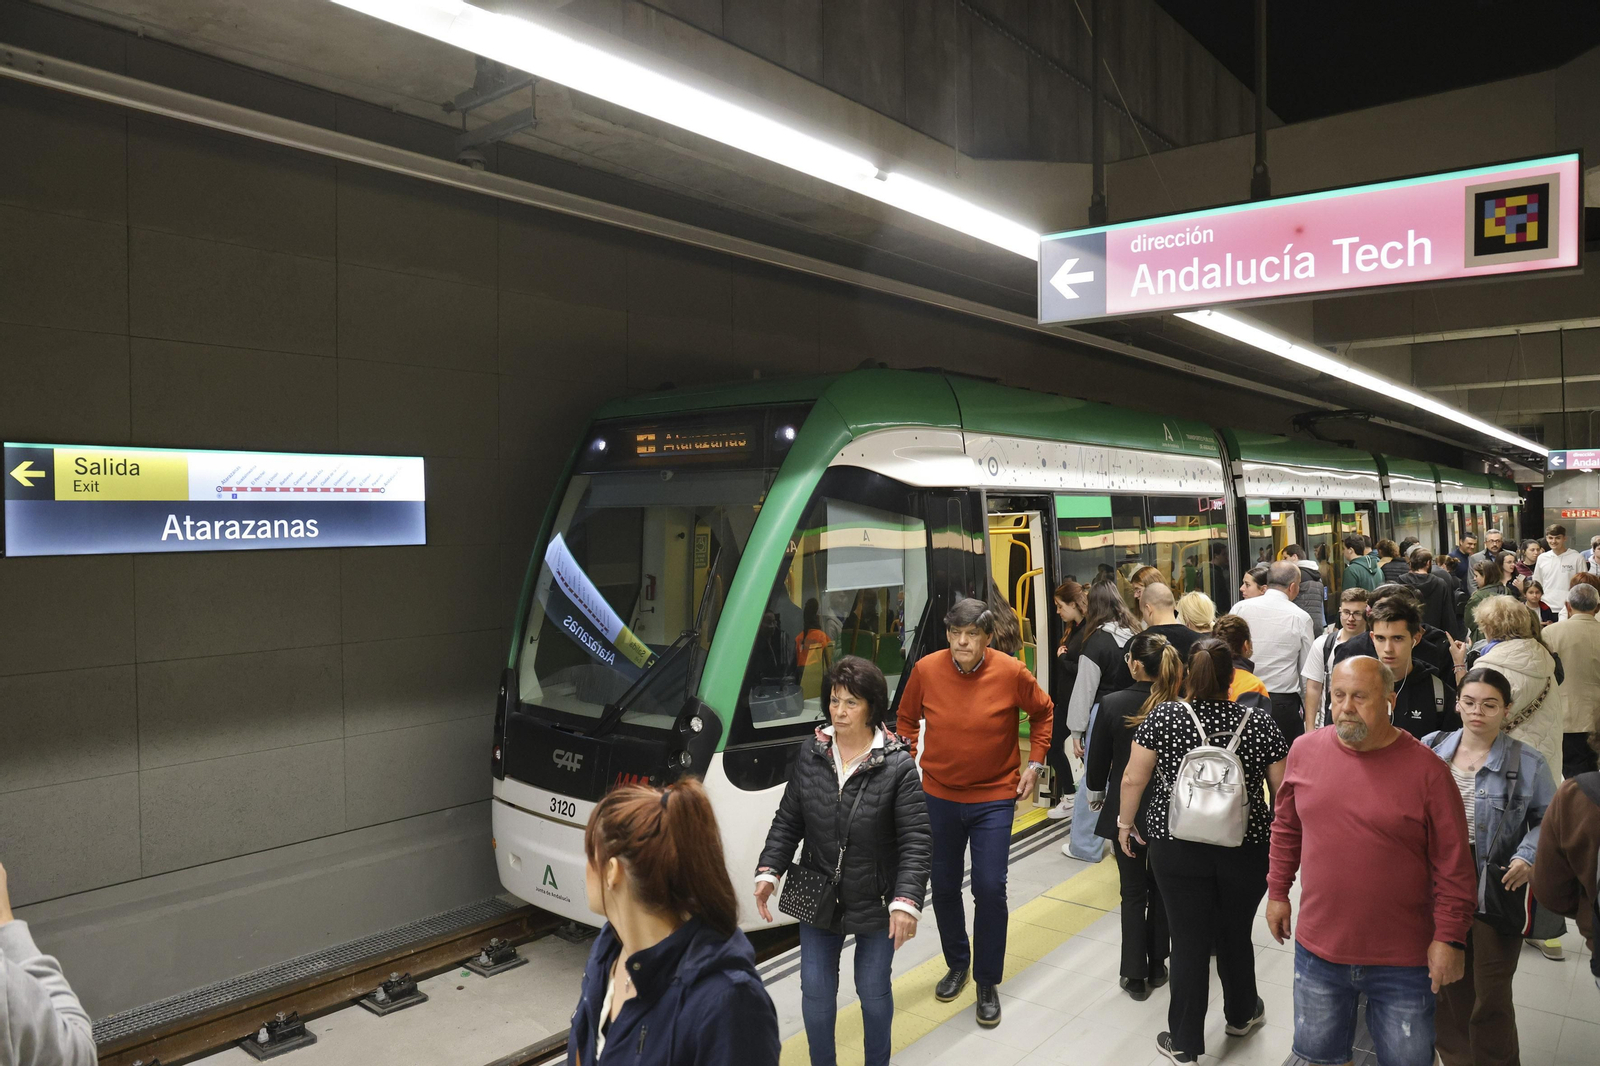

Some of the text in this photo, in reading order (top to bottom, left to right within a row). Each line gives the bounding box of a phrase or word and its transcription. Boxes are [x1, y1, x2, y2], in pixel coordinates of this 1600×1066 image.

[1129, 225, 1214, 253] dirección
[1130, 229, 1432, 298] Andalucía Tech
[73, 456, 141, 477] Salida
[73, 480, 100, 494] Exit
[160, 513, 320, 542] Atarazanas
[552, 749, 584, 772] CAF
[550, 798, 576, 818] 3120
